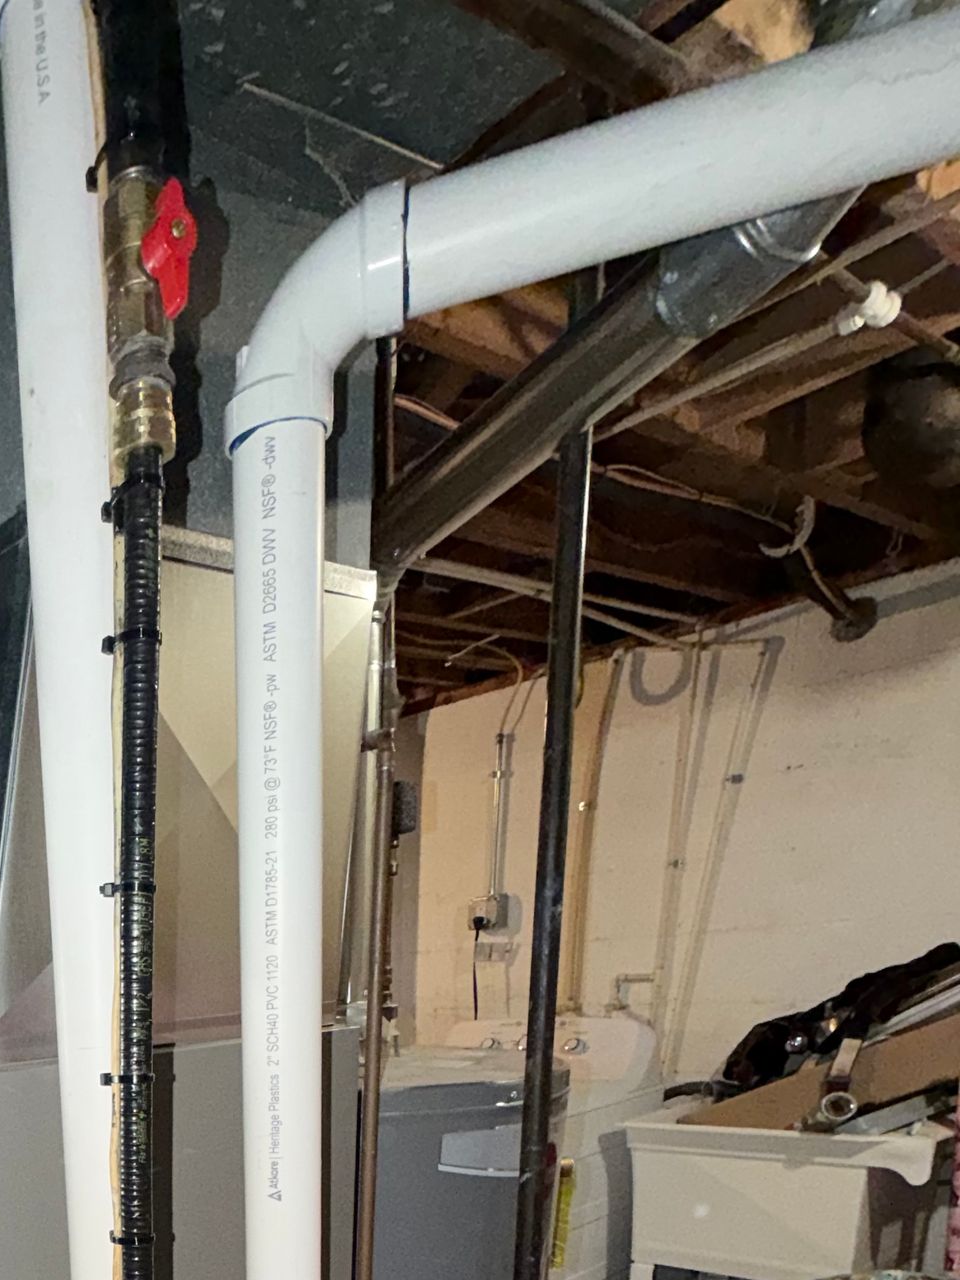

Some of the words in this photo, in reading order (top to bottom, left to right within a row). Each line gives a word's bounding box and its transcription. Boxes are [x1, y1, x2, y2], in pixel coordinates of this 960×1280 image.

[262, 528, 276, 565] DWV
[262, 568, 277, 614] D2665
[263, 621, 278, 662] ASTM
[264, 777, 281, 791] @
[265, 794, 281, 812] psi
[264, 816, 279, 839] 280
[264, 850, 279, 907] D1785-21
[265, 910, 279, 946] ASTM
[265, 954, 279, 982] 1120
[266, 985, 280, 1011] PVC
[266, 1013, 280, 1052] SCH40
[268, 1073, 280, 1112] Plastics
